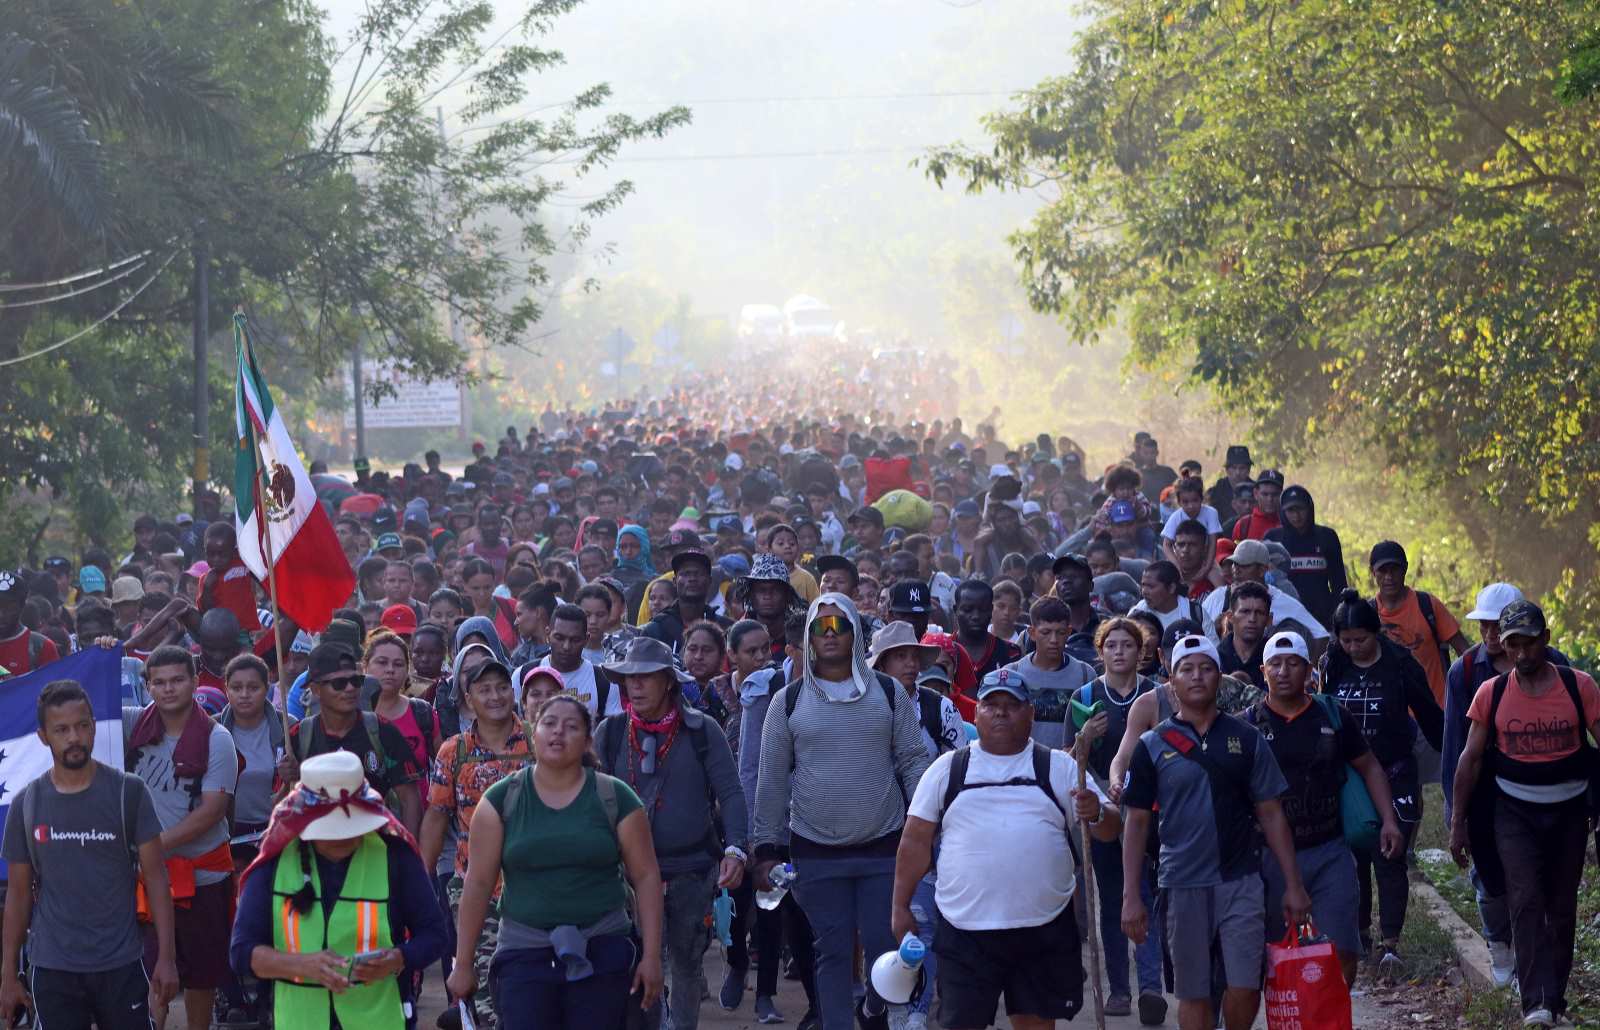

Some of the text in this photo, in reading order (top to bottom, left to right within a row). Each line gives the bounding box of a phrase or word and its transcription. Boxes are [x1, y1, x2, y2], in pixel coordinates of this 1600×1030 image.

[910, 588, 920, 601] NY
[1507, 716, 1570, 735] Calvin
[1518, 735, 1565, 753] Klein
[34, 824, 117, 847] Champion
